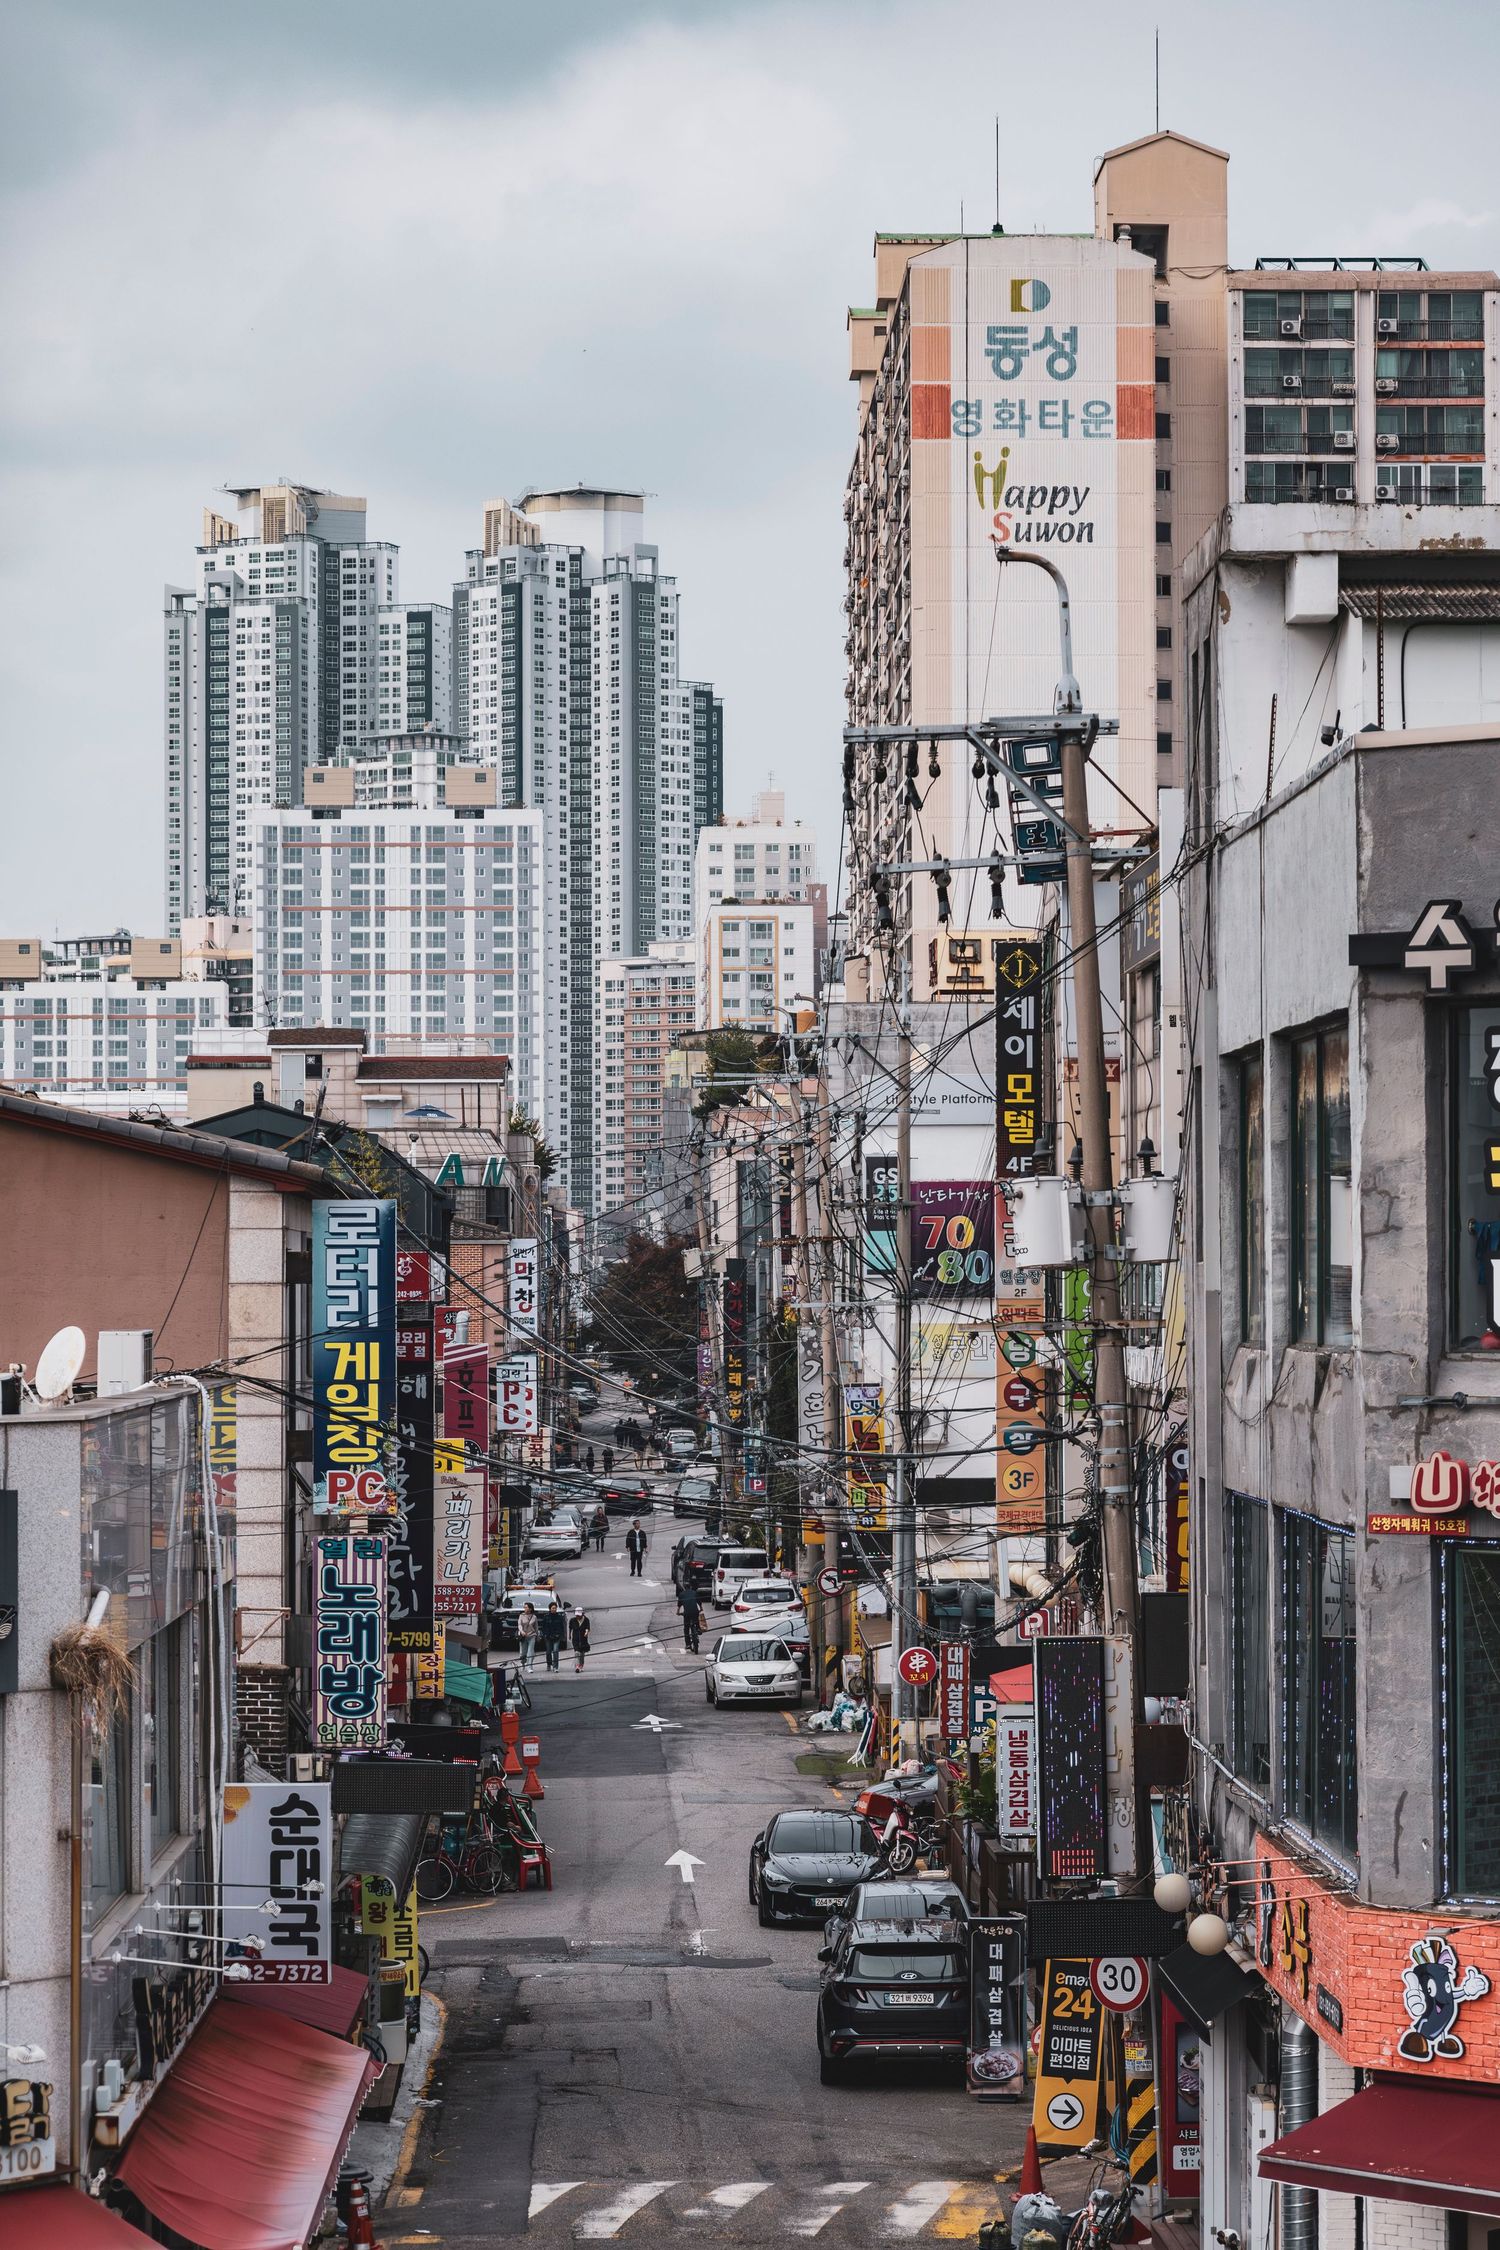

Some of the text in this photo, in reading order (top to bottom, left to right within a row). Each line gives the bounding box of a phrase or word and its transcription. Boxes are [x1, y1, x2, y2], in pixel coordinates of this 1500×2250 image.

[984, 326, 1080, 381] 동성
[951, 398, 1114, 439] 영화타운
[974, 447, 1091, 517] Happy
[988, 511, 1095, 545] Suwon
[1404, 903, 1500, 989] 수
[1003, 996, 1035, 1144] 제이 모텔
[885, 1094, 993, 1106] Lifstyle Platform
[873, 1167, 898, 1185] GS
[1006, 1156, 1033, 1173] 4F
[920, 1215, 976, 1250] 70
[937, 1250, 994, 1285] 80
[1000, 1269, 1043, 1286] 연습장
[515, 1262, 535, 1314] 막창
[1014, 1288, 1027, 1298] 2F
[324, 1206, 384, 1464] 로터리 게임장
[396, 1332, 426, 1344] 요리
[503, 1381, 520, 1425] PC
[327, 1470, 386, 1507] PC
[753, 1478, 762, 1490] P
[1009, 1469, 1034, 1490] 3F
[1371, 1517, 1466, 1533] 산청자매훠궈 15호점
[318, 1537, 383, 1560] 열린
[443, 1498, 473, 1583] 페리카나
[317, 1563, 385, 1719] 노래방
[908, 1651, 929, 1673] 串
[908, 1673, 929, 1682] 꼬치
[947, 1646, 964, 1735] 대패삼겹살
[975, 1700, 997, 1722] P
[318, 1722, 381, 1745] 연습장
[1008, 1730, 1031, 1828] 냉동삼겹살
[268, 1792, 321, 1957] 순대국
[228, 1964, 323, 1982] 2-7372
[1055, 1972, 1091, 1987] emar
[1102, 1964, 1136, 1992] 30
[988, 1943, 1003, 2048] 대패삼겹살
[1053, 1986, 1096, 2020] 24
[1052, 2024, 1093, 2034] DELICIOUS IDEA
[1051, 2036, 1092, 2054] 이마트
[1049, 2053, 1091, 2071] 편의점
[1179, 2129, 1200, 2140] 샤브
